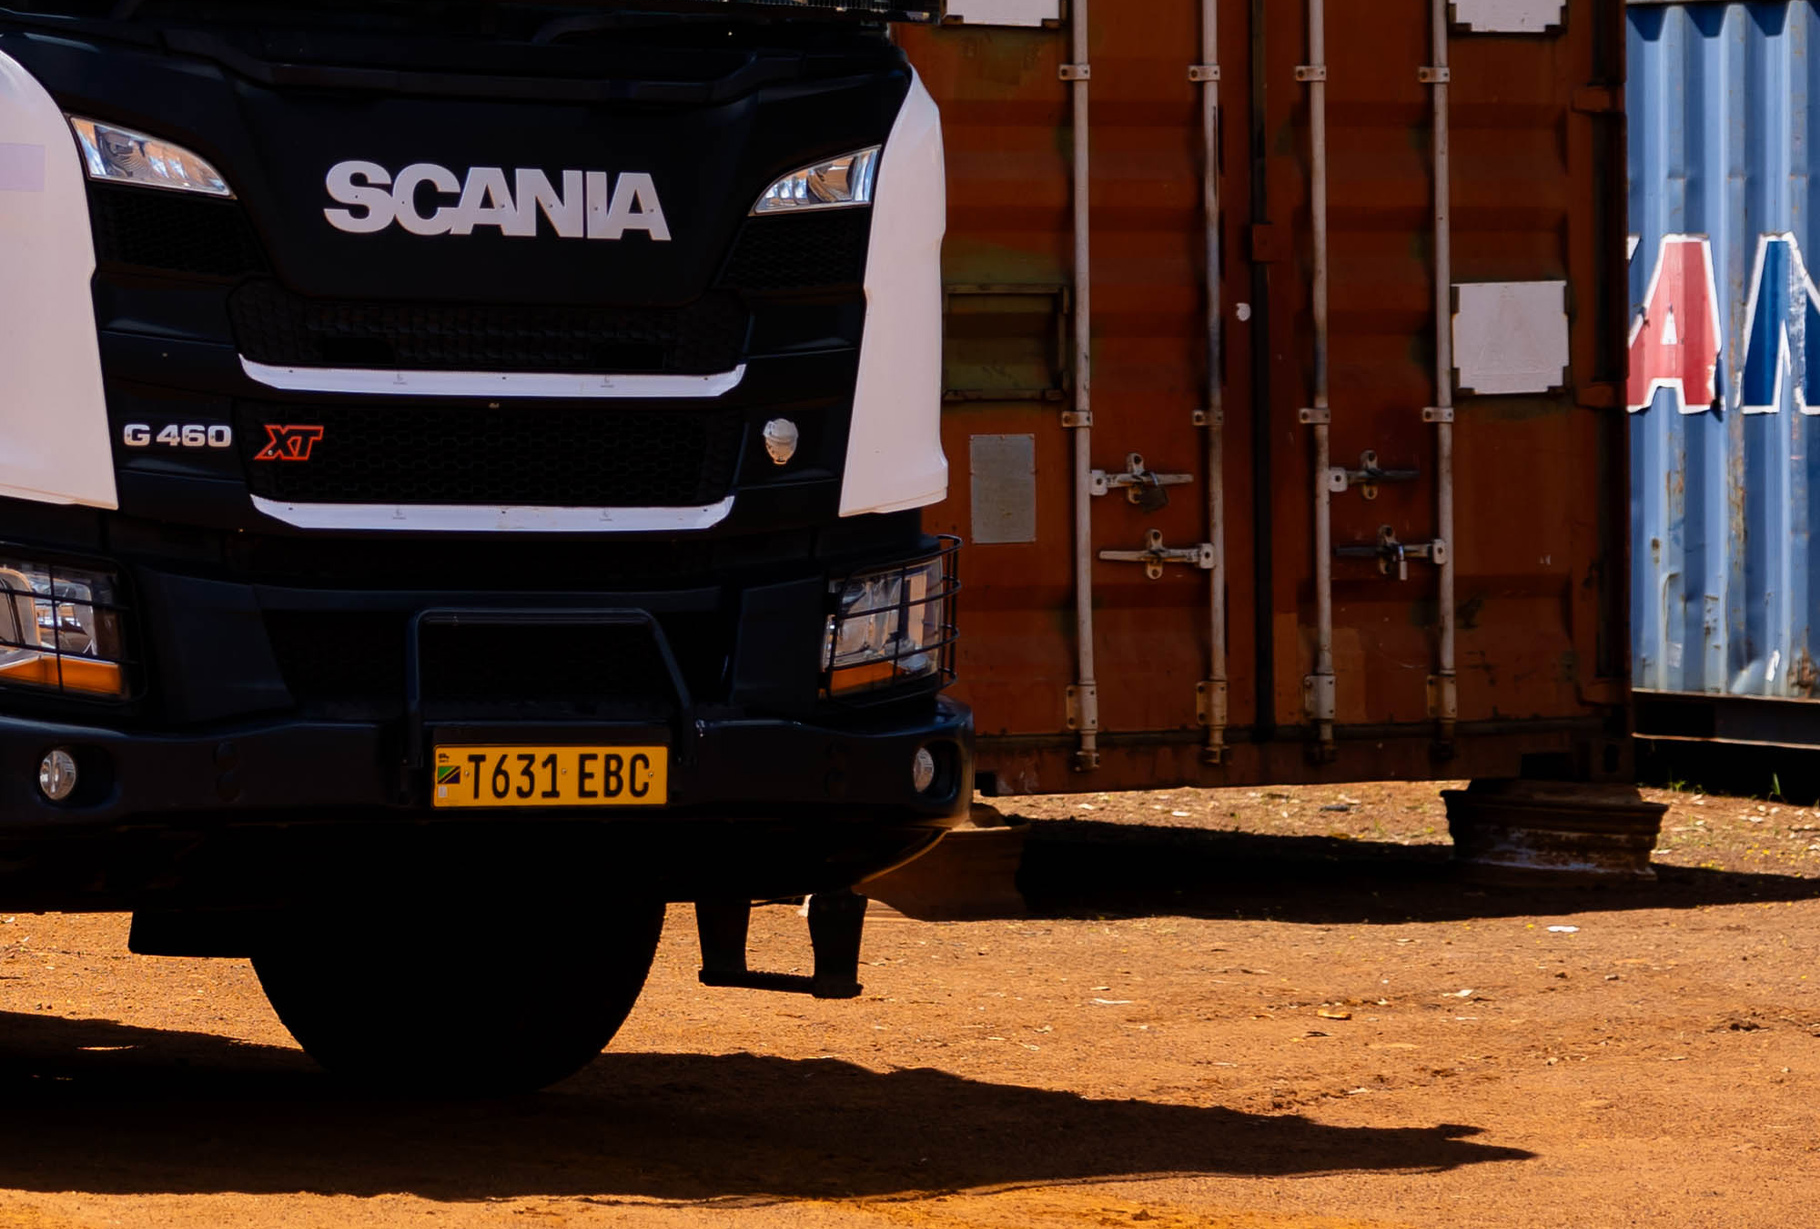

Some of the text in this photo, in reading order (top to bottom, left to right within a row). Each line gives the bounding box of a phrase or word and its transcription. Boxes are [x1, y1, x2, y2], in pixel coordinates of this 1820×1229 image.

[323, 160, 672, 241] SCANIA
[123, 424, 232, 448] G 460
[253, 423, 325, 461] XT
[467, 753, 650, 800] T631 EBC
